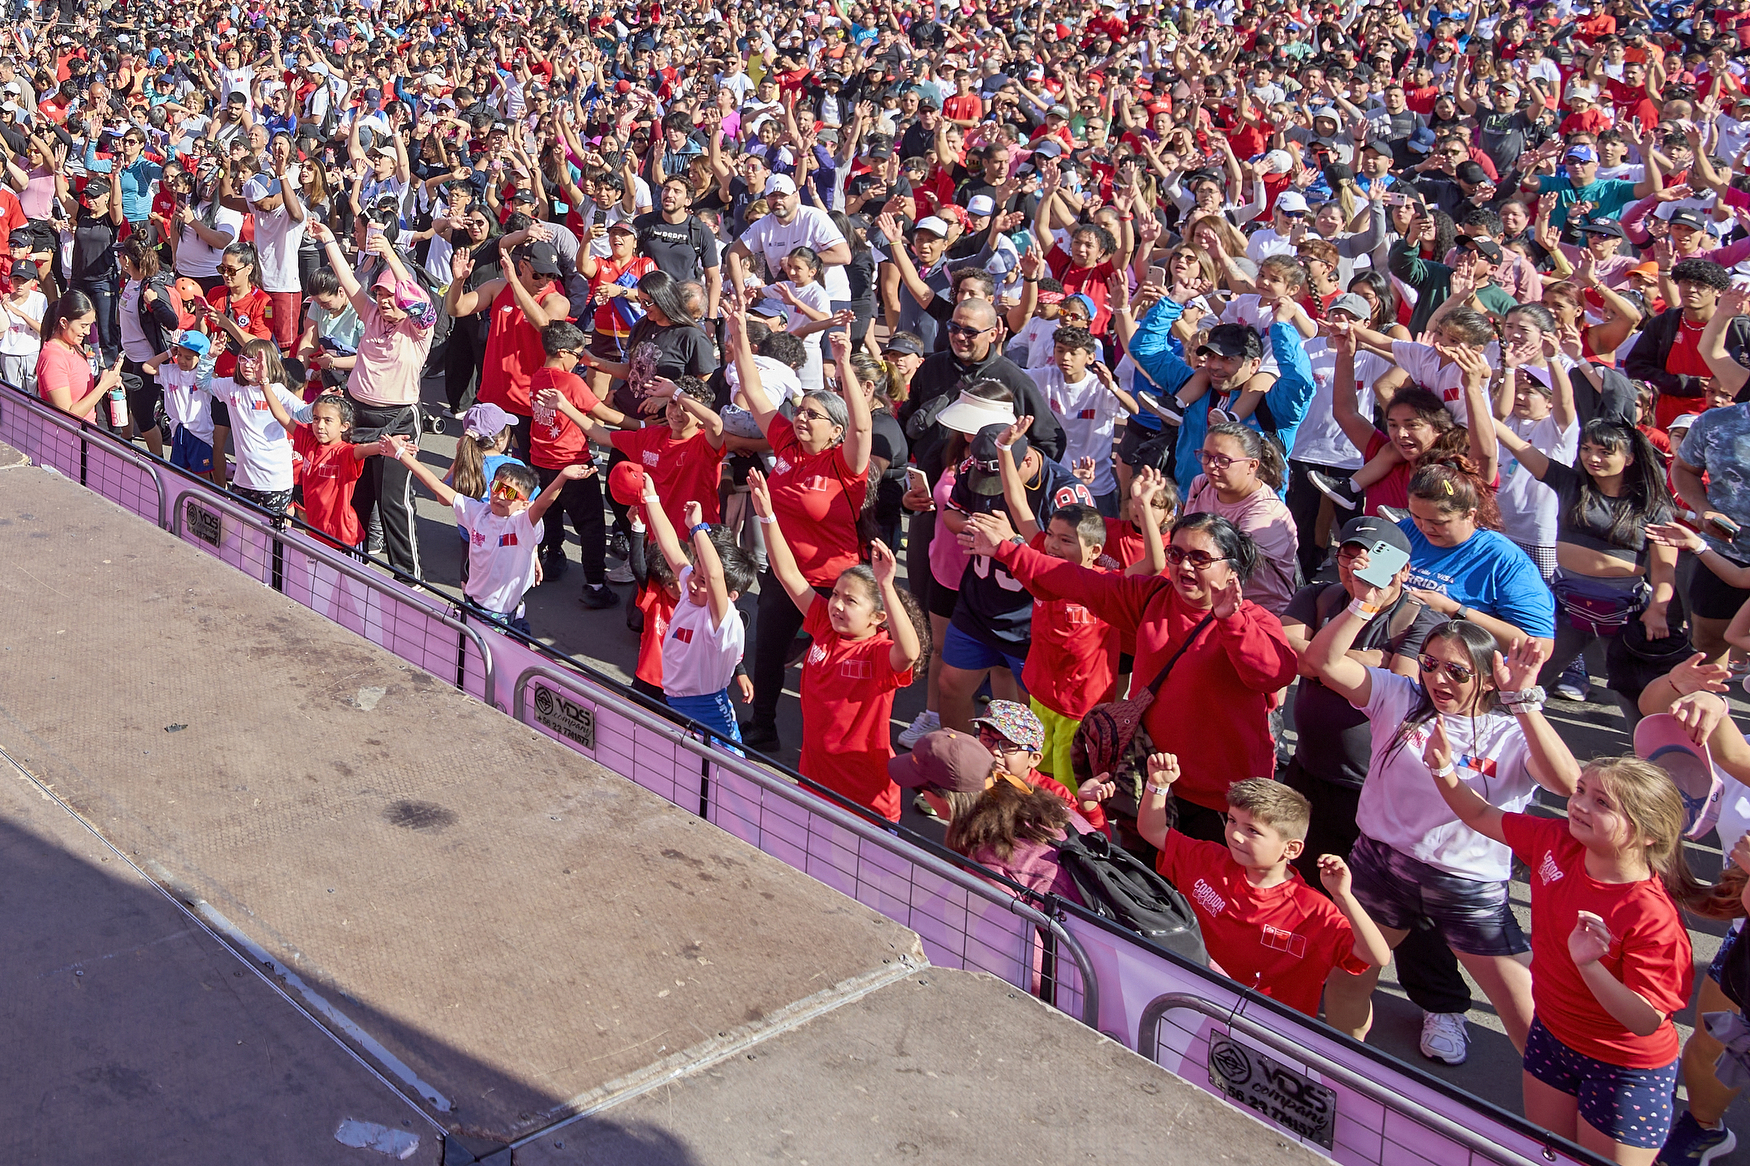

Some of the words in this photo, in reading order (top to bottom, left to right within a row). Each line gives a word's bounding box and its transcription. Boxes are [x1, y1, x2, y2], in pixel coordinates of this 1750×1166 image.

[198, 508, 219, 530] VDS
[1436, 573, 1454, 584] VISA
[553, 713, 593, 737] company
[555, 696, 590, 726] VDS
[1194, 878, 1226, 913] CORRIDA
[1256, 1055, 1328, 1114] VDS
[1251, 1082, 1329, 1132] company
